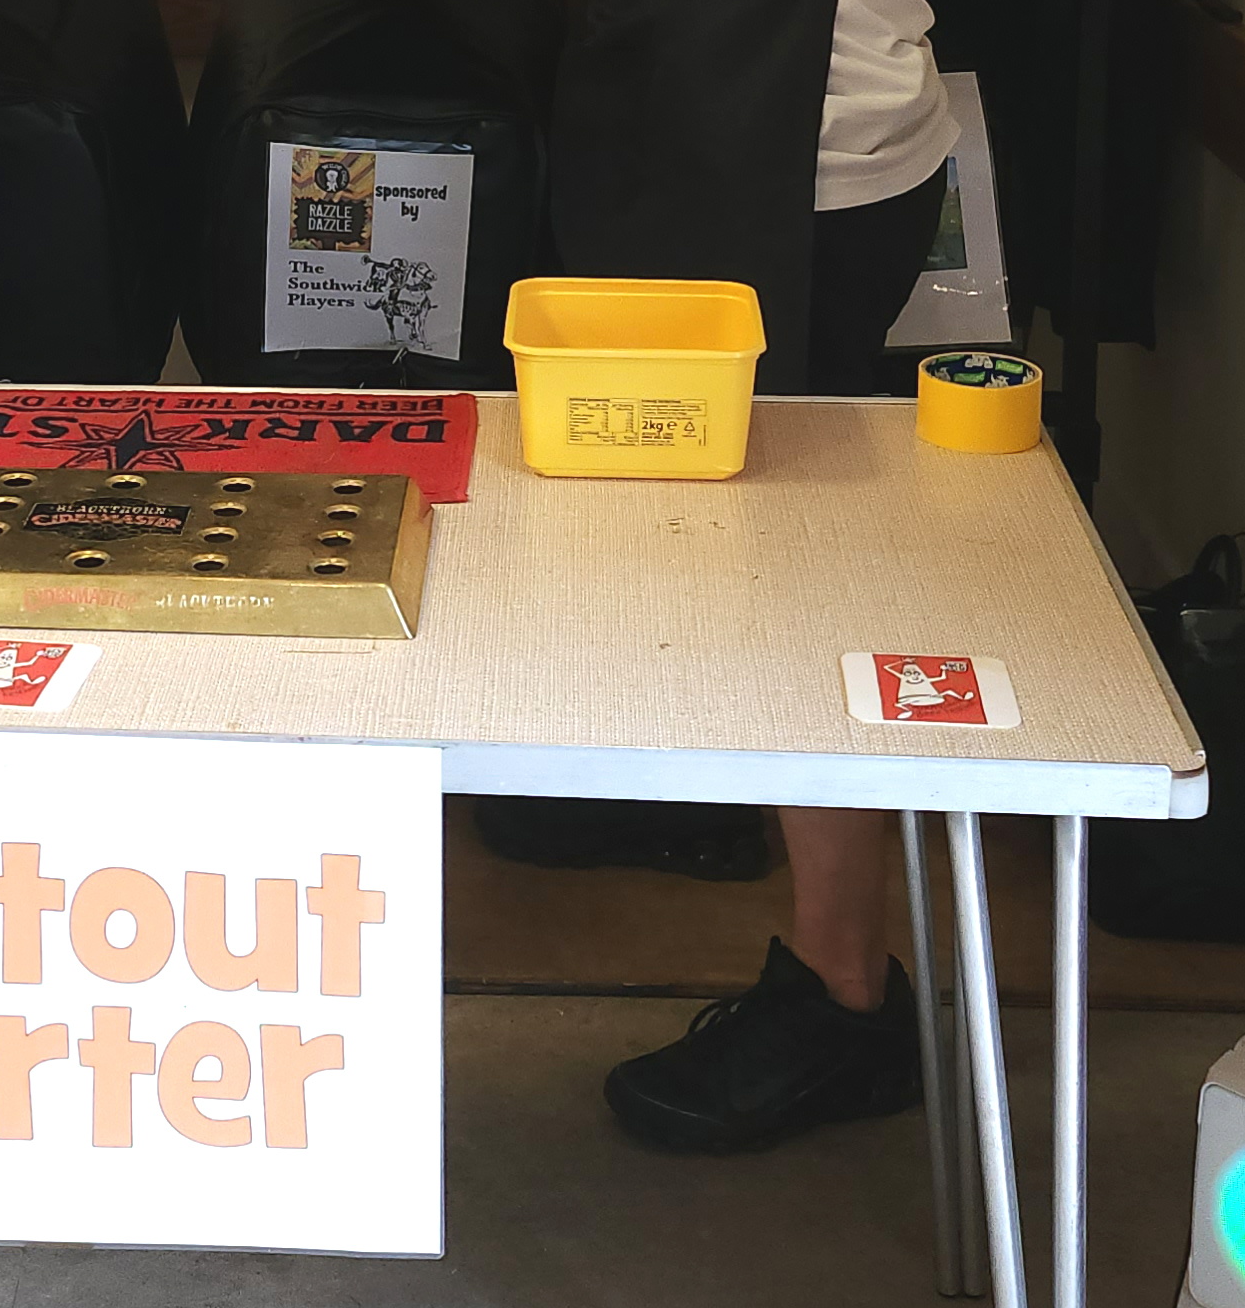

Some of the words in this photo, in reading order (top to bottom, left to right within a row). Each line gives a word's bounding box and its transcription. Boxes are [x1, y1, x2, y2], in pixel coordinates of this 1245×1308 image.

[374, 184, 448, 203] sponsored
[308, 203, 353, 219] RAZZLE
[400, 201, 420, 222] by
[307, 217, 353, 233] DAZZLE
[288, 259, 325, 275] The
[287, 293, 355, 310] Players
[2, 395, 46, 408] OF
[53, 394, 167, 409] HEART
[175, 397, 233, 410] THE
[248, 397, 345, 411] FROM
[356, 397, 444, 412] BEER
[192, 417, 451, 443] DARK
[641, 419, 664, 435] 2kg
[56, 504, 168, 515] BLACKTHORN
[30, 513, 183, 529] CIDERMASTER
